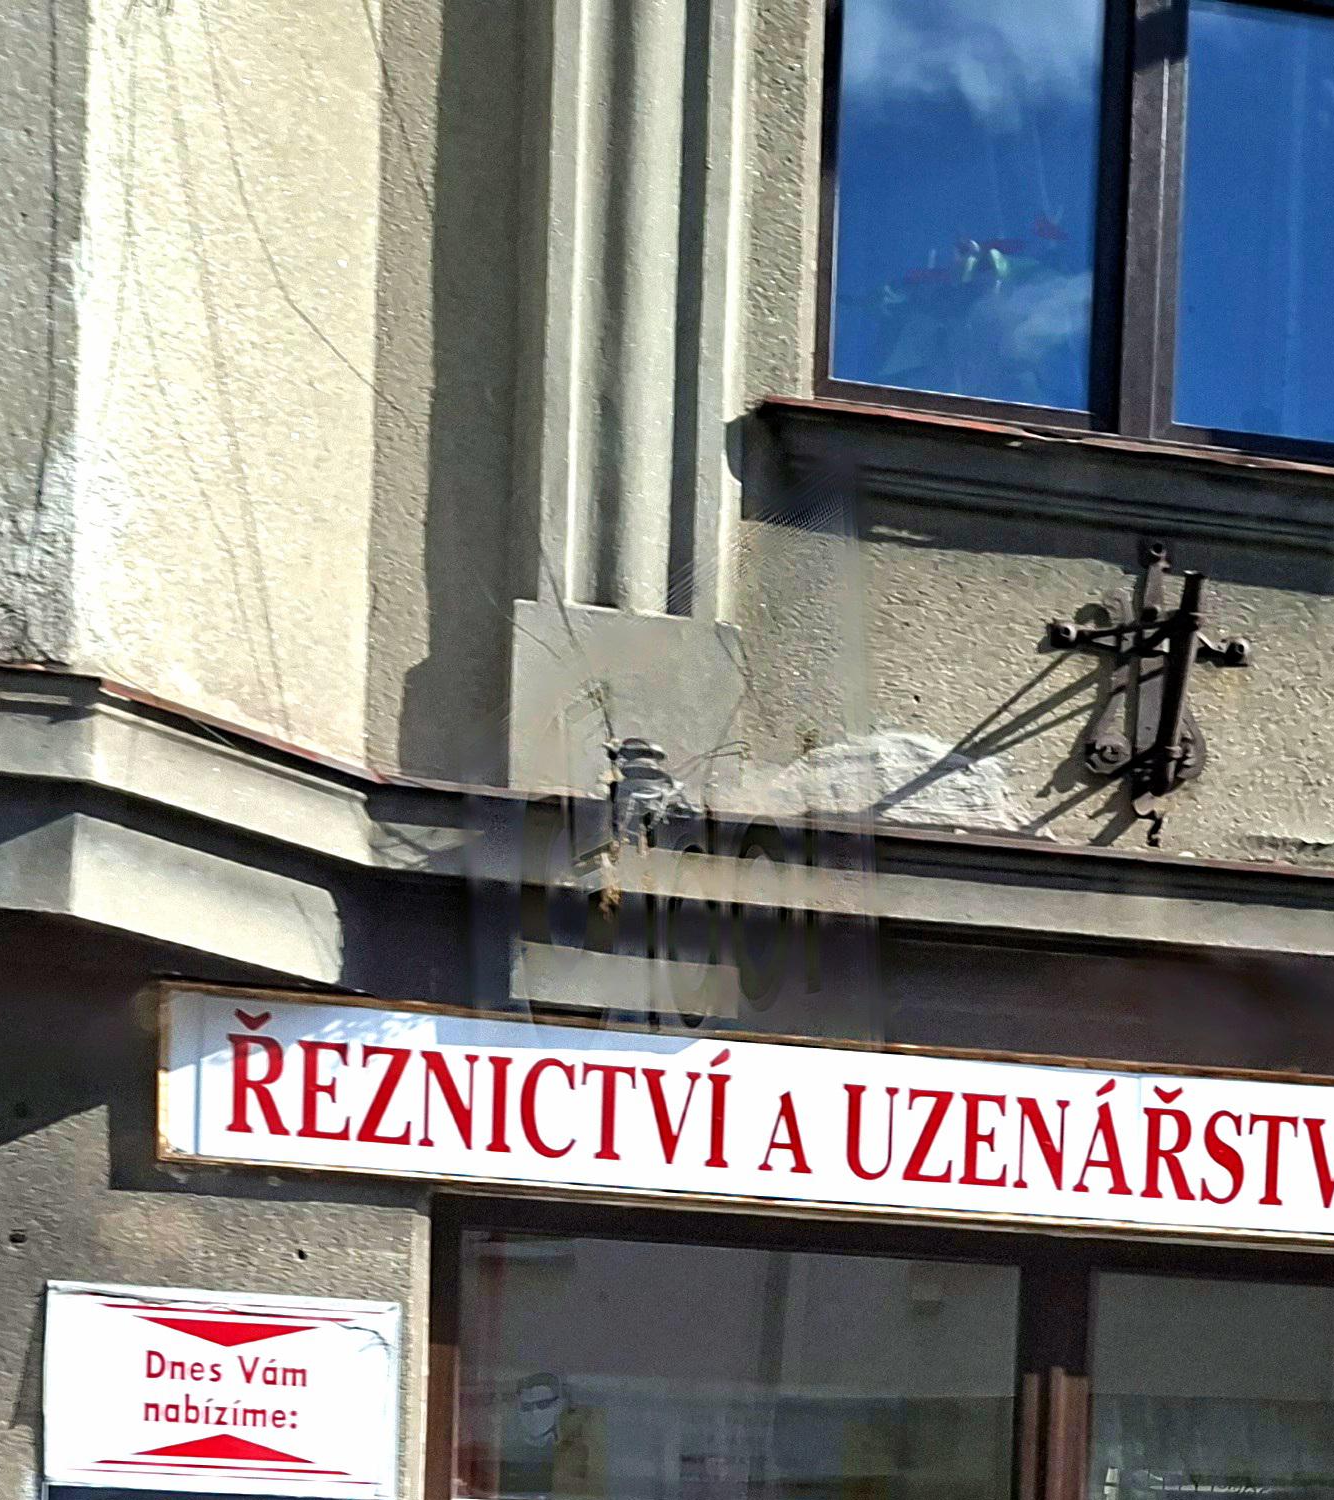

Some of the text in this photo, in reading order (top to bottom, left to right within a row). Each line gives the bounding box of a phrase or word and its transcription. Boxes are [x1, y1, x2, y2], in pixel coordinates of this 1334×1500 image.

[226, 1007, 733, 1170] ŘEZNICTVÍ
[758, 1090, 813, 1176] A
[145, 1350, 308, 1388] Dnes Vám
[142, 1394, 299, 1430] nabízíme:
